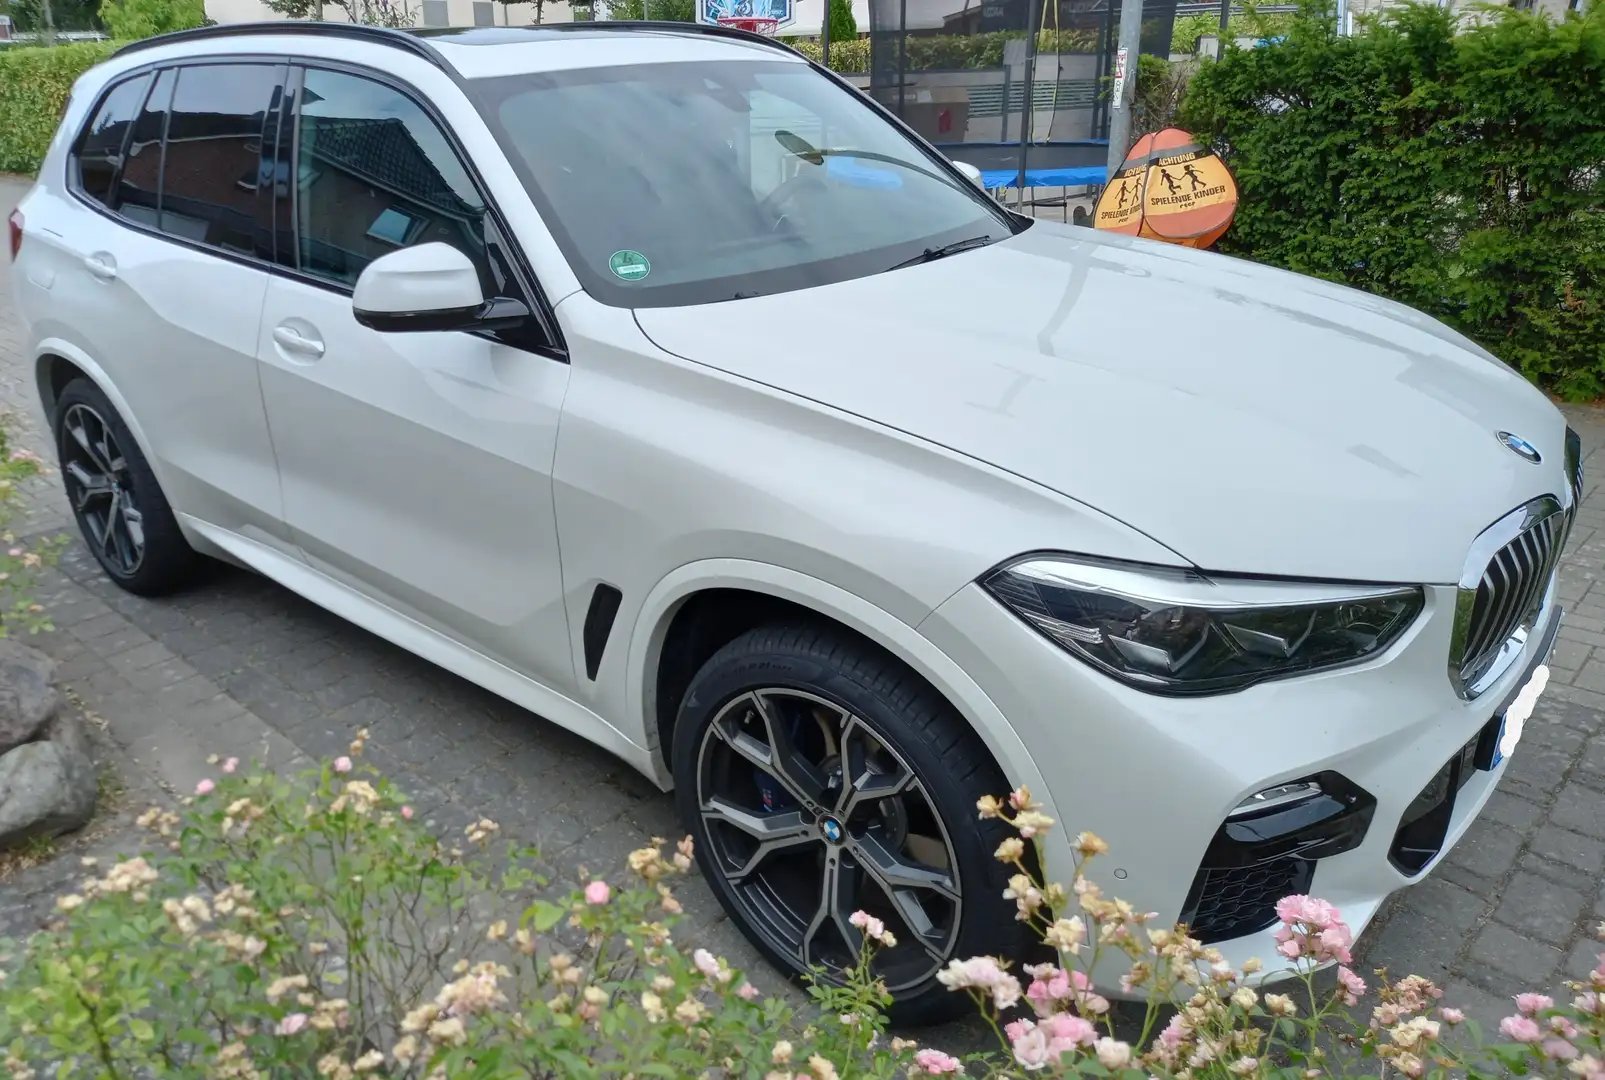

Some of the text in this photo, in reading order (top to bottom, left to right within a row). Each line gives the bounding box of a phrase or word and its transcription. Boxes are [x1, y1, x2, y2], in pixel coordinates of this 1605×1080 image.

[1158, 152, 1196, 167] ACHTUNG
[1151, 185, 1226, 206] SPIELENDE KINDER
[1101, 208, 1130, 220] SPIELENDE
